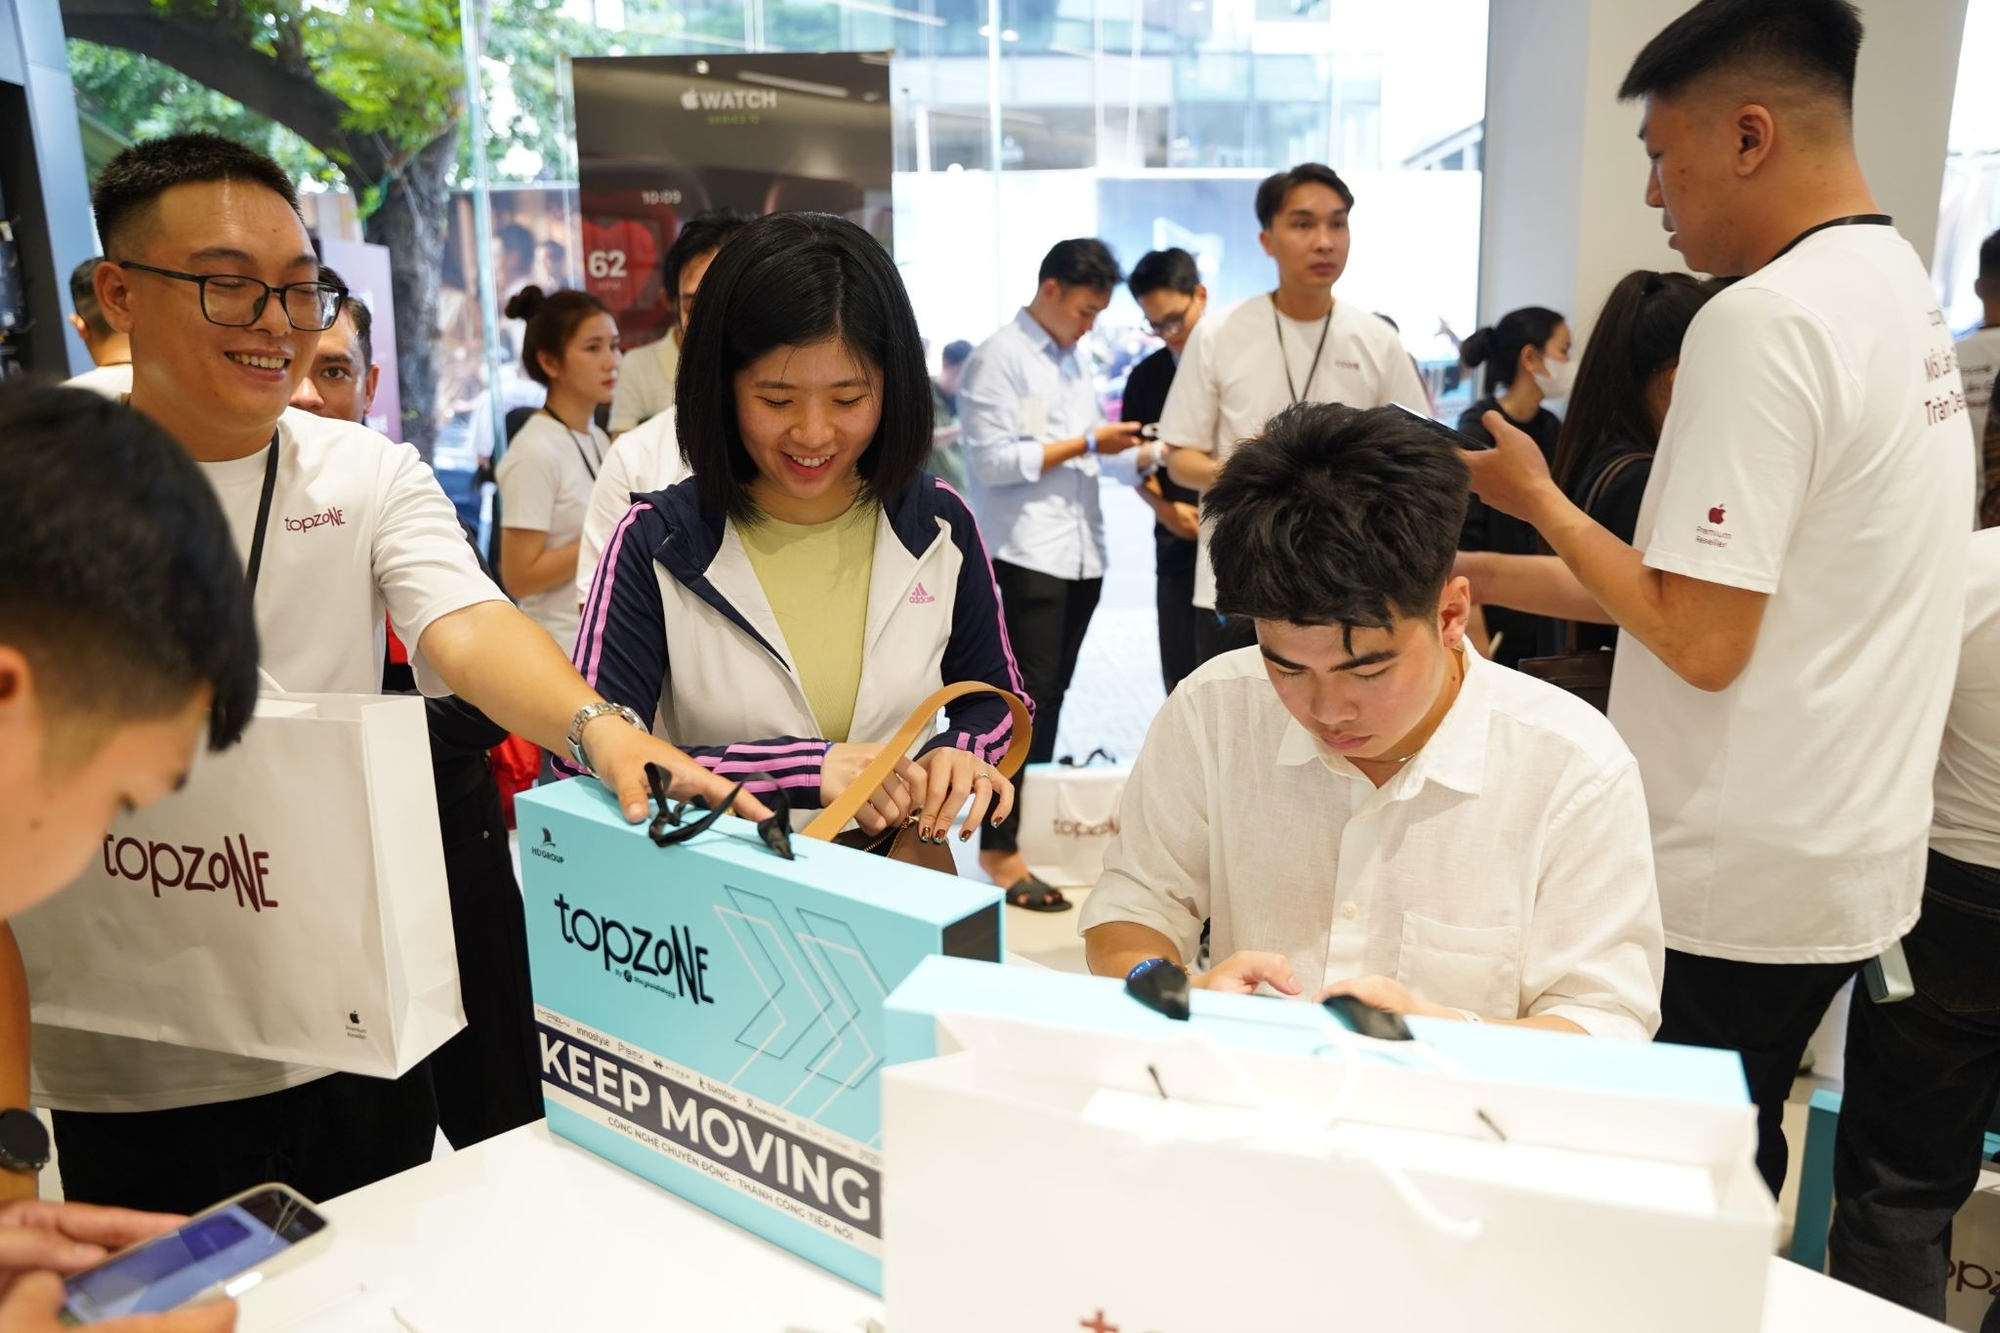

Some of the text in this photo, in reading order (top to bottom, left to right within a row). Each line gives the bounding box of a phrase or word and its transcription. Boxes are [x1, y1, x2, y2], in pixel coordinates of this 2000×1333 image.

[700, 89, 778, 110] WATCH
[642, 189, 682, 205] 10:09
[588, 249, 628, 279] 62
[539, 1031, 871, 1222] KEEP MOVING
